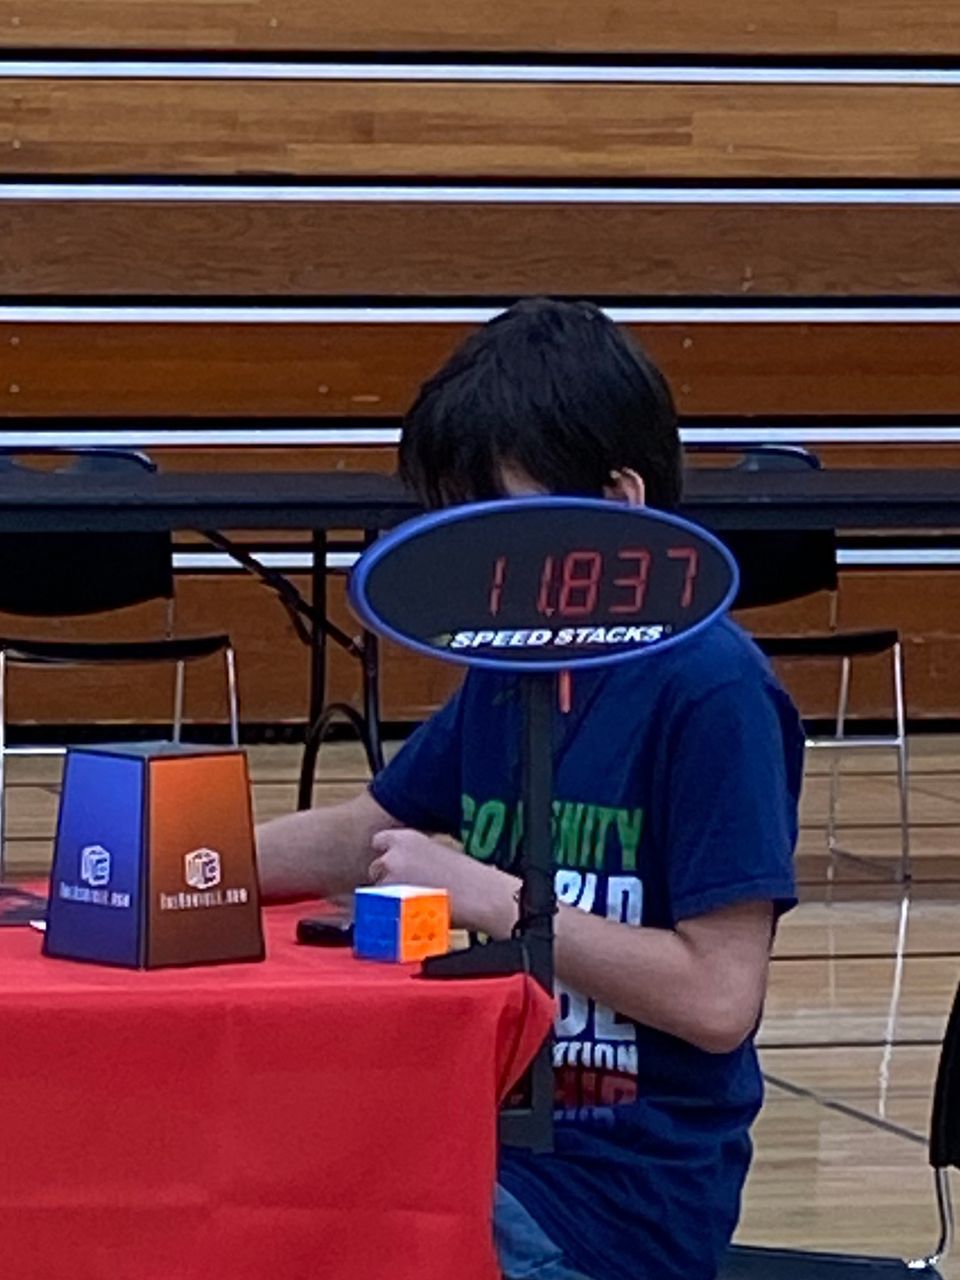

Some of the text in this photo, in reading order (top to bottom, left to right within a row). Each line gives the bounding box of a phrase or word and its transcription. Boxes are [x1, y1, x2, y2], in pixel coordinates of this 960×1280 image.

[487, 547, 698, 618] 11.837
[450, 625, 664, 648] SPEED STACKS
